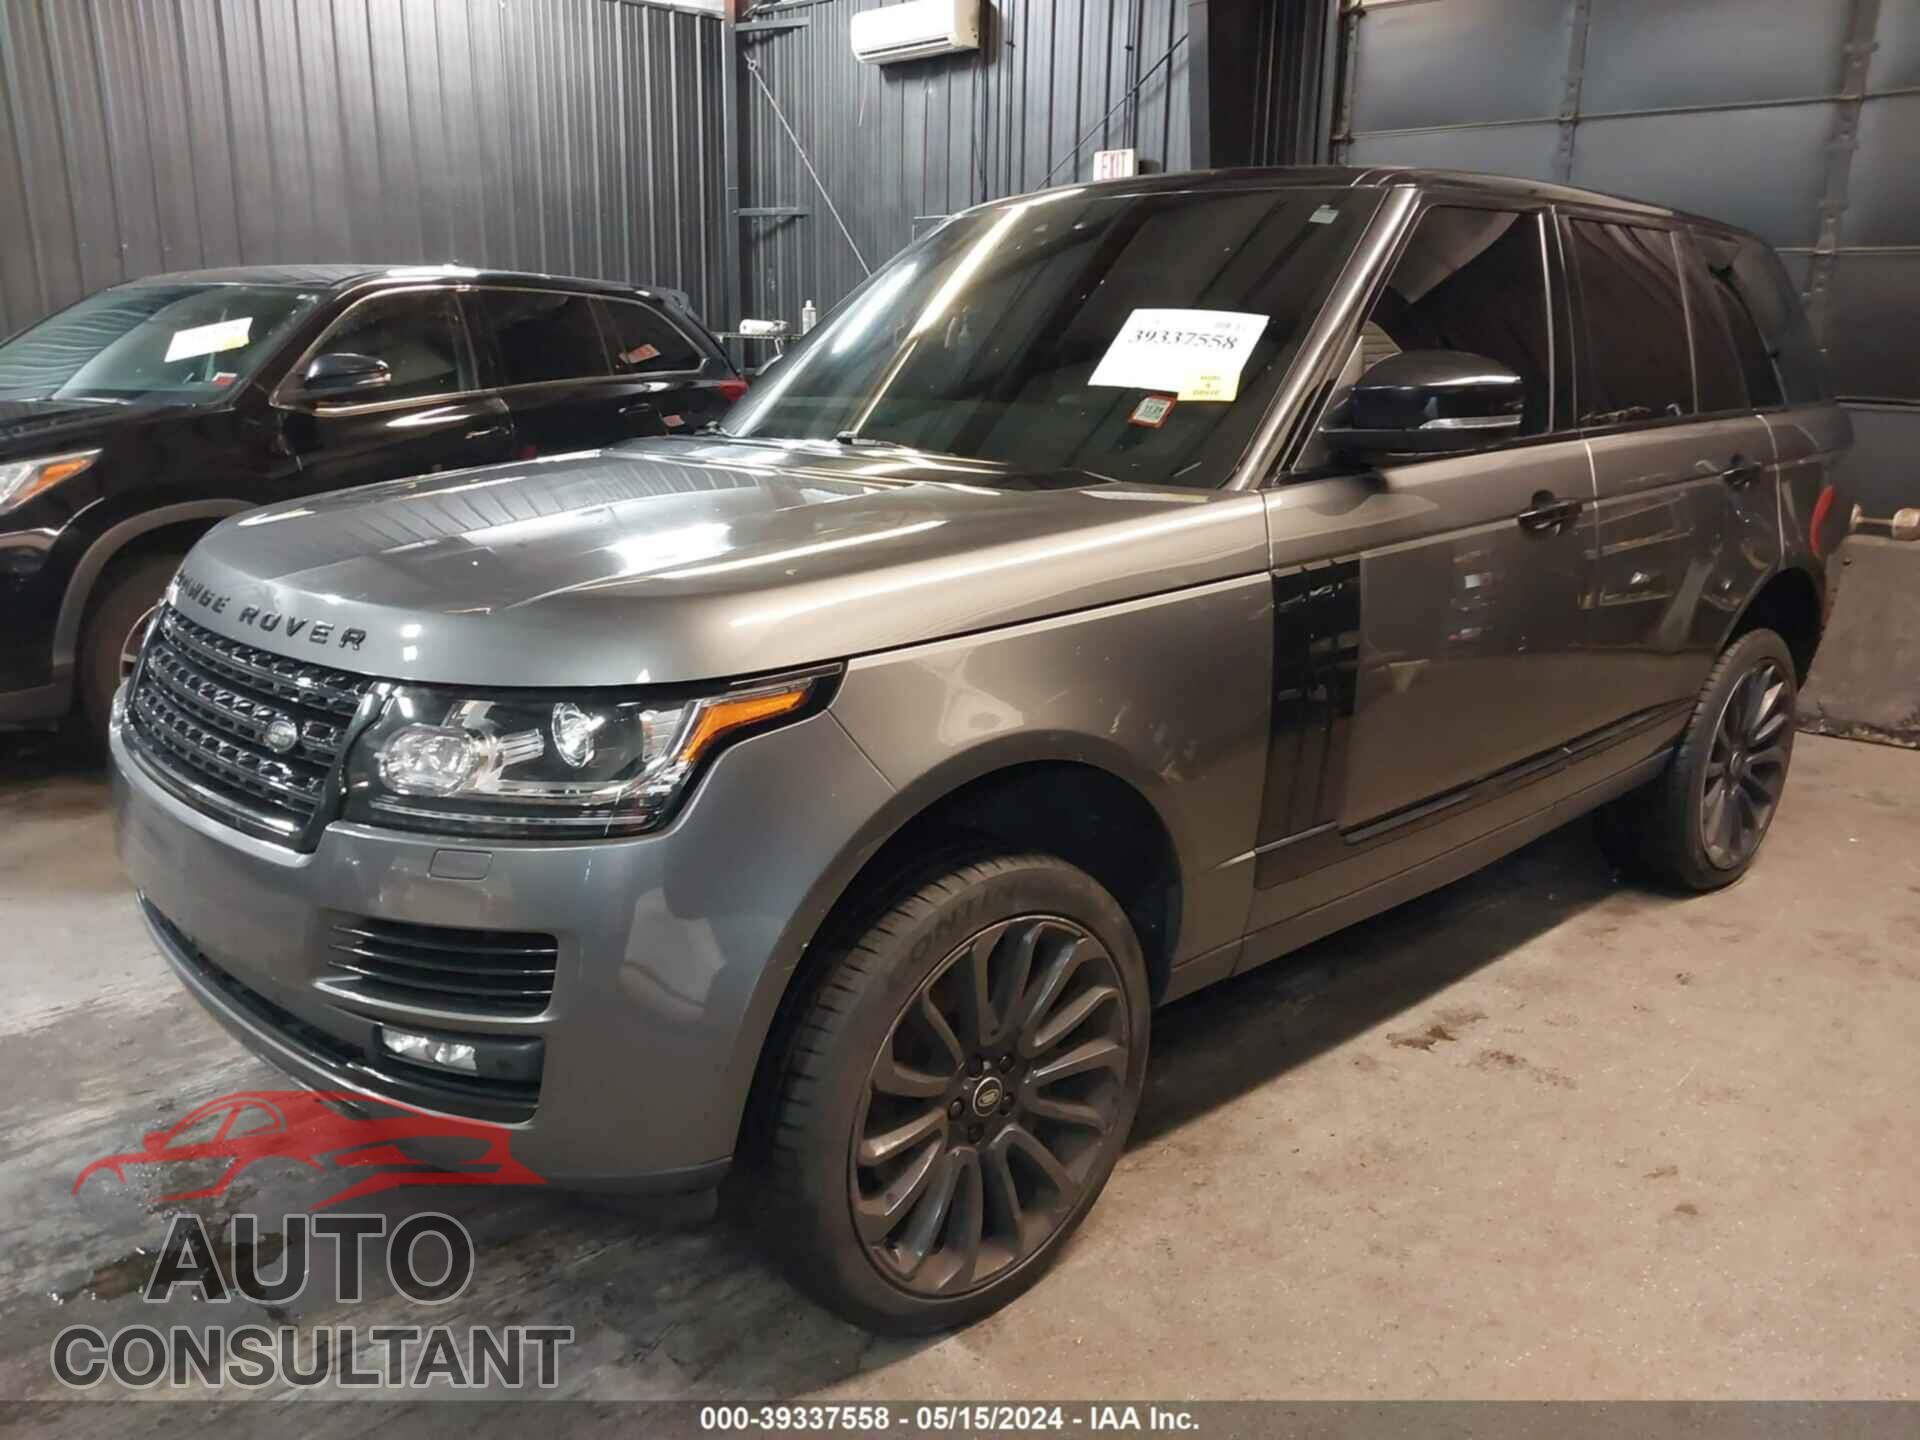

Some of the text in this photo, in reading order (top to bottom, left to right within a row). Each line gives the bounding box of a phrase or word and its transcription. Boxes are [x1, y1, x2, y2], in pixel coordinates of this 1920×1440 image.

[1101, 151, 1128, 179] EXIT
[1128, 328, 1239, 350] 39337558
[239, 605, 367, 651] ROVER
